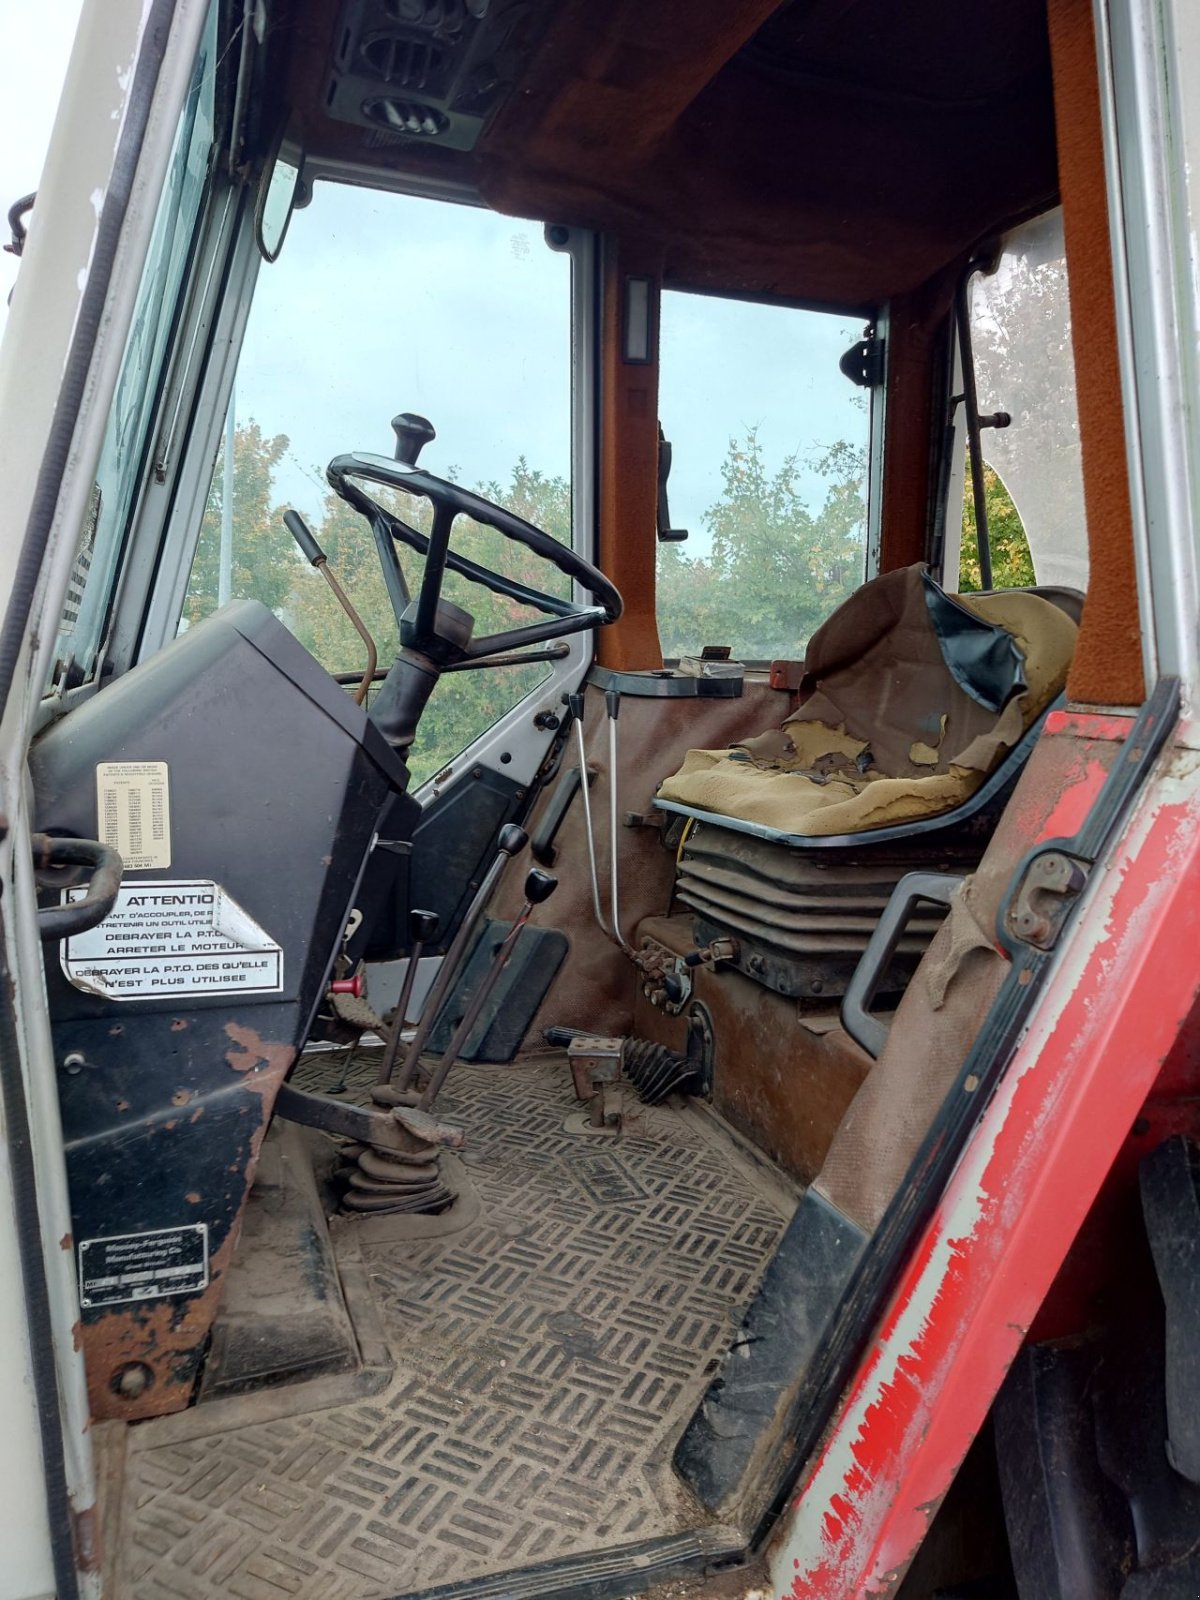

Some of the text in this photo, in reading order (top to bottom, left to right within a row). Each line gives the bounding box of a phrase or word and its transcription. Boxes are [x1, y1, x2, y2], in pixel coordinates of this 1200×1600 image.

[126, 894, 214, 906] ATTENTIO
[105, 932, 172, 941] DEBRAYER
[176, 931, 192, 939] LA
[106, 945, 167, 954] ARRETER
[191, 942, 244, 951] MOTEUR
[75, 961, 269, 977] DEBRAYER LA P.T.O. DES QU'ELLE
[105, 974, 247, 988] N'EST PLUS UTILISEE
